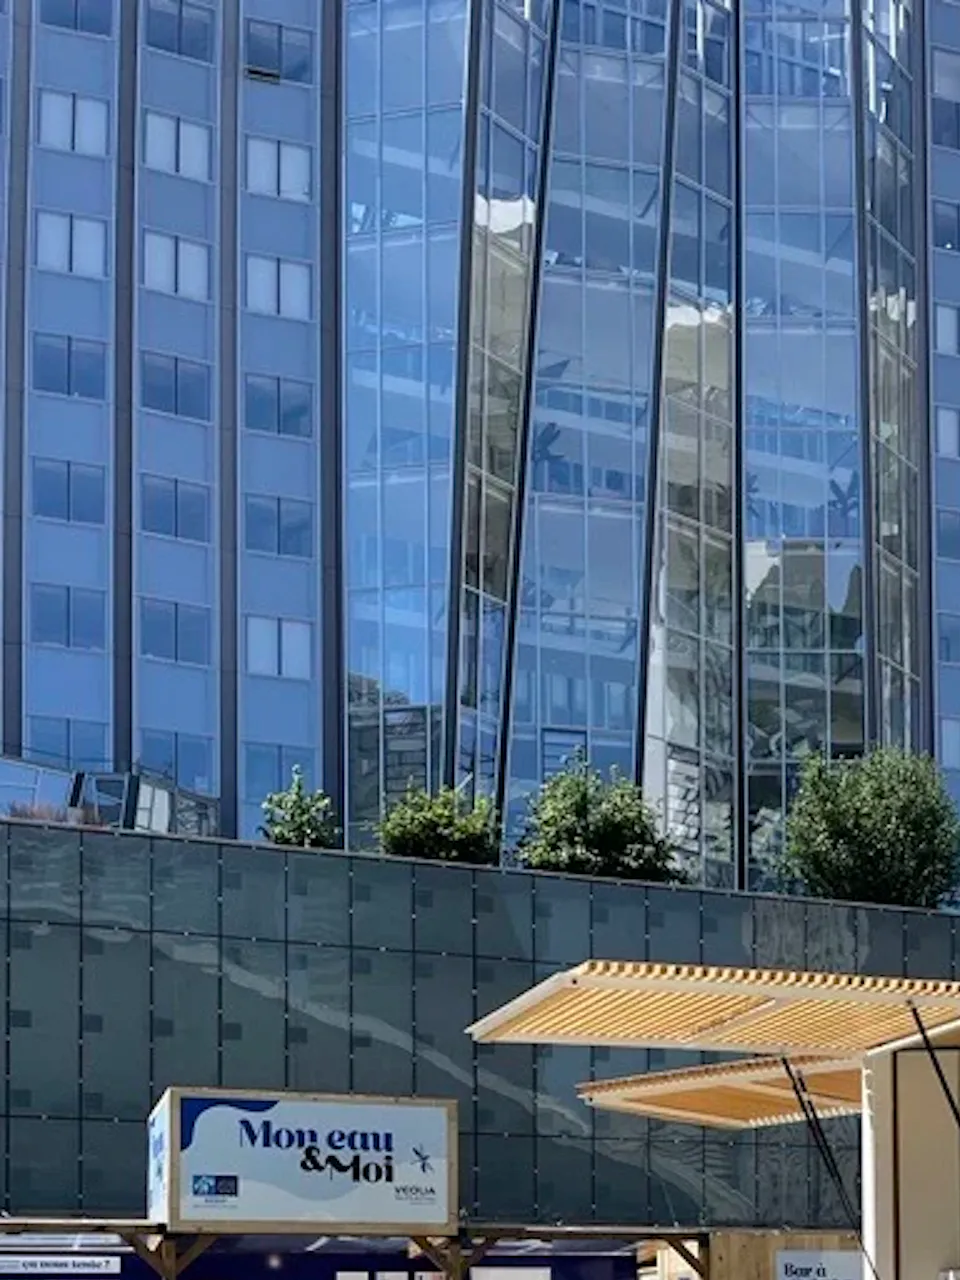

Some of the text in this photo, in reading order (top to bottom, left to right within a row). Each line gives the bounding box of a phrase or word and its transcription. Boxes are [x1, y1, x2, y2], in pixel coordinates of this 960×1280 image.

[239, 1119, 393, 1152] Mon eau
[300, 1145, 394, 1183] &Moi
[394, 1185, 436, 1196] VEOLIA
[784, 1262, 826, 1277] Bar à
